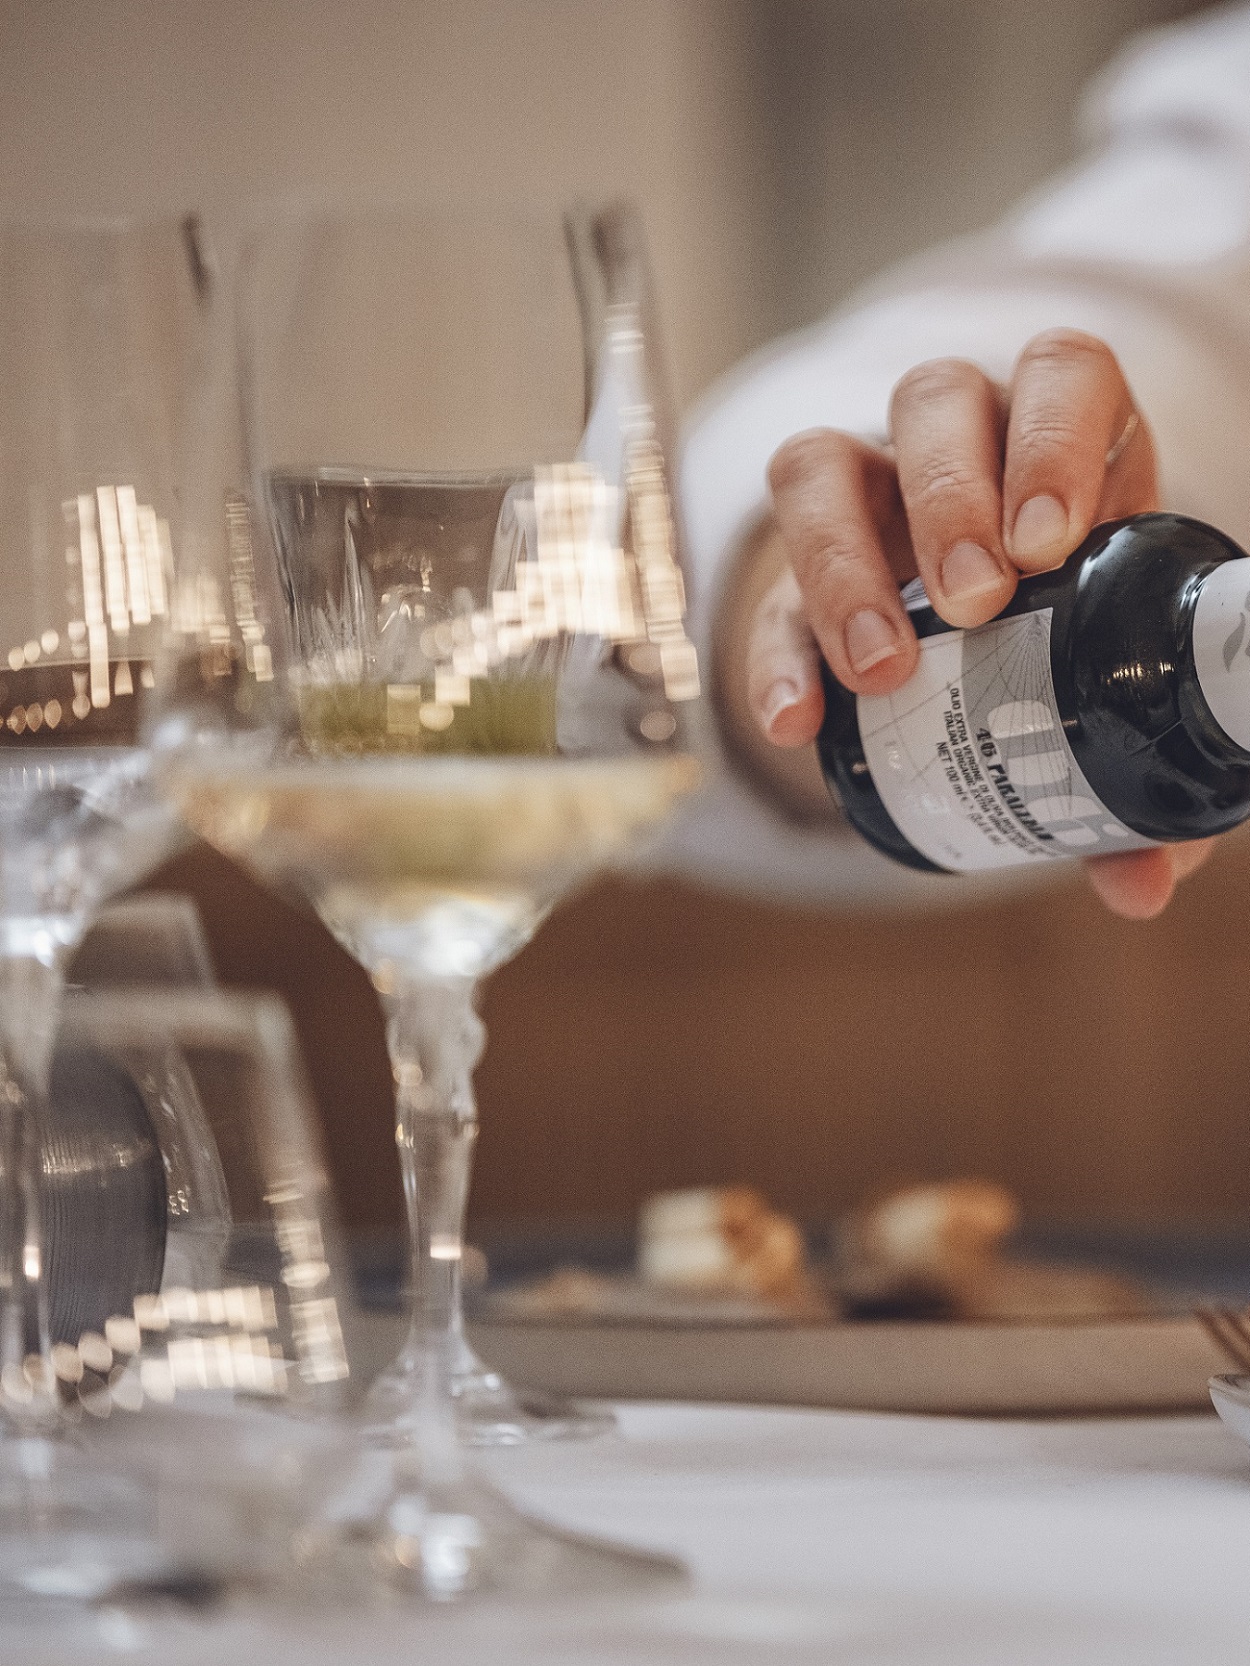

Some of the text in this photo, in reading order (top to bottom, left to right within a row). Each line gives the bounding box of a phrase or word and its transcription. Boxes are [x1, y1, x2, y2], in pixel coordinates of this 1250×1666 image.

[936, 741, 951, 763] NET
[944, 765, 959, 782] 100
[943, 711, 957, 746] ITALIAN
[954, 748, 975, 786] ORGANIC
[971, 788, 990, 812] EXTRA
[949, 688, 961, 710] OLIO
[955, 712, 968, 742] EXTRA
[963, 744, 983, 781] VERGINE
[976, 728, 997, 758] 46
